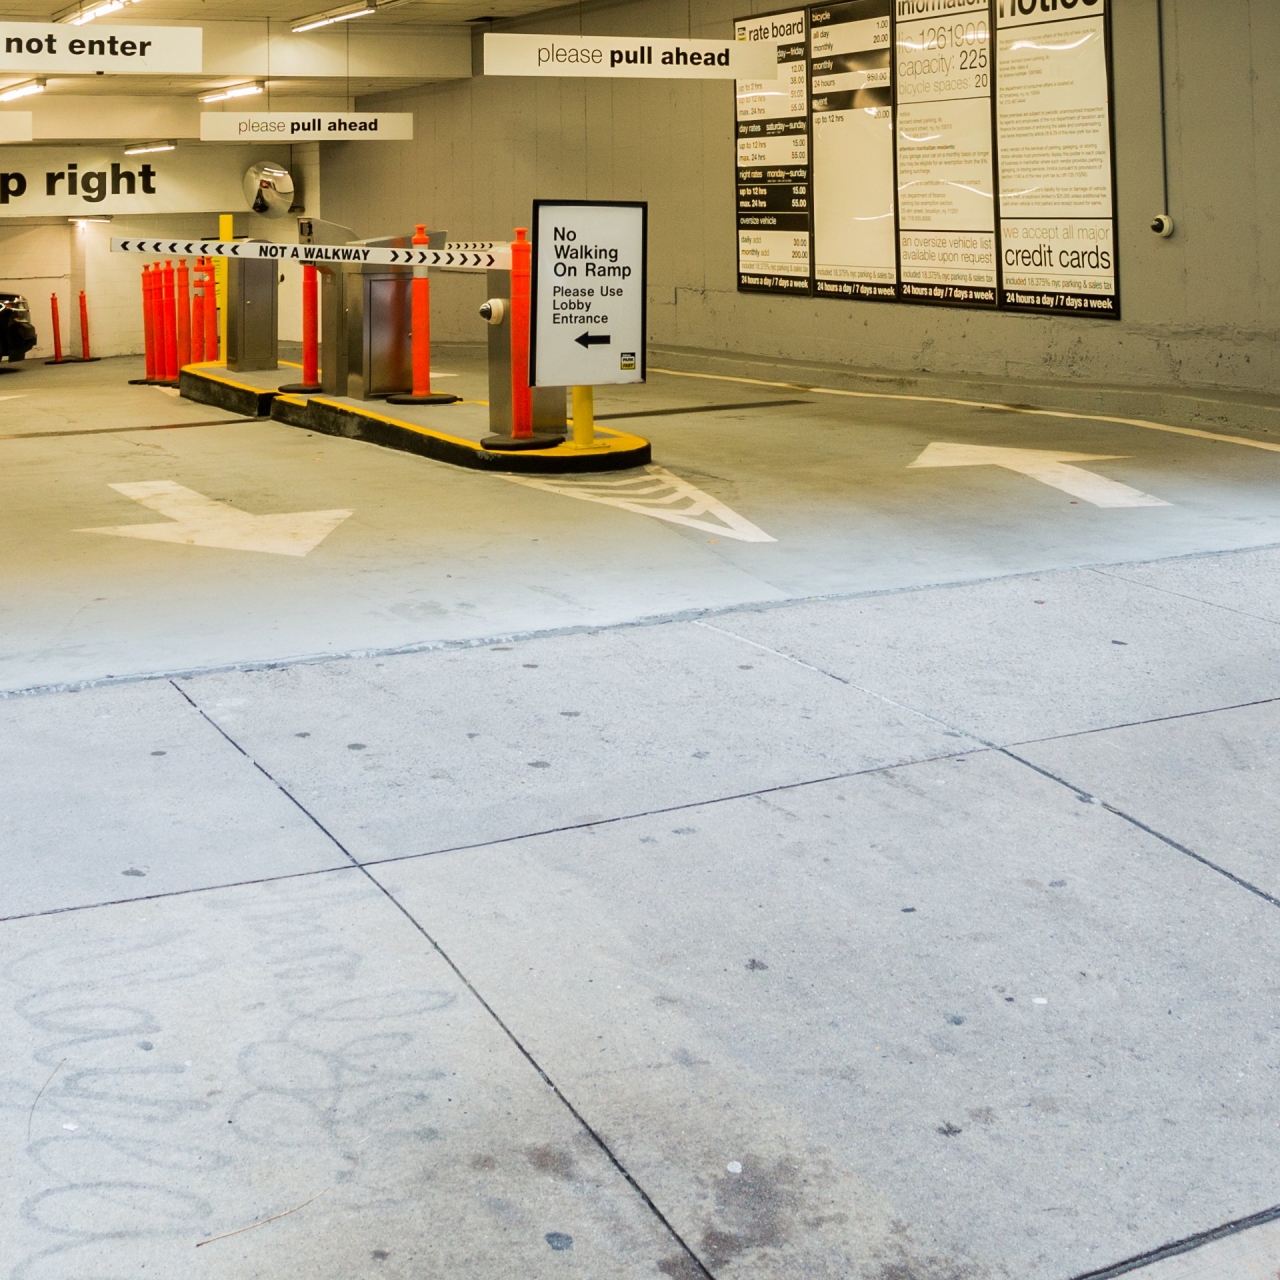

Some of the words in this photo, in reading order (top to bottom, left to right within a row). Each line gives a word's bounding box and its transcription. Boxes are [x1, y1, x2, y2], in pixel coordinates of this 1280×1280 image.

[812, 11, 831, 23] bicycle
[749, 24, 770, 41] rate
[771, 17, 803, 39] board
[876, 20, 888, 29] 1.00
[819, 30, 829, 40] day
[873, 34, 888, 44] 20.00
[5, 33, 57, 55] not
[68, 35, 152, 57] enter
[813, 42, 834, 52] monthly
[537, 43, 603, 67] please
[609, 46, 653, 68] pull
[660, 47, 730, 67] ahead
[791, 64, 804, 73] 12.00
[813, 60, 834, 71] monthly
[898, 53, 955, 79] capacity:
[959, 48, 988, 70] 225
[790, 76, 804, 85] 38.00
[814, 80, 820, 88] 24
[820, 79, 835, 87] hours
[899, 80, 931, 97] bicycle
[933, 77, 971, 95] spaces:
[974, 73, 988, 88] 20
[790, 102, 805, 112] 55.00
[814, 116, 821, 125] up
[828, 115, 834, 123] 12
[835, 114, 844, 122] hrs
[238, 118, 286, 136] please
[290, 118, 322, 135] pull
[327, 117, 379, 132] ahead
[739, 124, 748, 134] day
[748, 123, 761, 132] rates
[739, 142, 745, 150] up
[752, 141, 758, 149] 12
[759, 140, 767, 148] hrs
[792, 138, 806, 147] 15.00
[751, 153, 757, 161] 24
[791, 150, 806, 159] 55.00
[45, 163, 157, 203] right
[740, 216, 759, 225] oversize
[759, 216, 777, 225] vehicle
[553, 227, 577, 242] No
[1003, 227, 1019, 238] we
[1022, 226, 1060, 241] accept
[1062, 225, 1074, 239] all
[1077, 225, 1110, 242] major
[741, 235, 752, 245] daily
[752, 236, 761, 244] add
[793, 238, 807, 247] 30.00
[902, 237, 912, 247] an
[914, 236, 947, 249] oversize
[949, 237, 978, 249] vehicle
[980, 238, 992, 249] list
[258, 245, 287, 258] NOT
[291, 246, 299, 259] A
[304, 247, 371, 261] WALKWAY
[554, 245, 619, 262] Walking
[741, 248, 760, 258] monthly
[760, 249, 769, 257] add
[791, 250, 808, 259] 200.00
[902, 250, 936, 262] available
[938, 252, 959, 264] upon
[960, 252, 993, 266] request
[1004, 244, 1054, 267] credit
[1058, 245, 1111, 269] cards
[553, 262, 577, 277] On
[585, 262, 632, 280] Ramp
[1005, 277, 1027, 286] included
[1051, 280, 1061, 289] nyc
[1062, 278, 1082, 290] parking
[1083, 280, 1088, 288] &
[1088, 280, 1102, 289] sales
[1103, 281, 1113, 290] tax
[552, 286, 595, 297] Please
[600, 286, 624, 297] Use
[552, 299, 592, 312] Lobby
[1006, 292, 1015, 303] 24
[1016, 292, 1035, 304] hours
[1036, 296, 1041, 304] a
[1041, 294, 1055, 307] day
[1060, 295, 1065, 306] 7
[1065, 295, 1082, 309] days
[1083, 298, 1089, 307] a
[1090, 297, 1113, 309] week
[552, 313, 609, 324] Entrance
